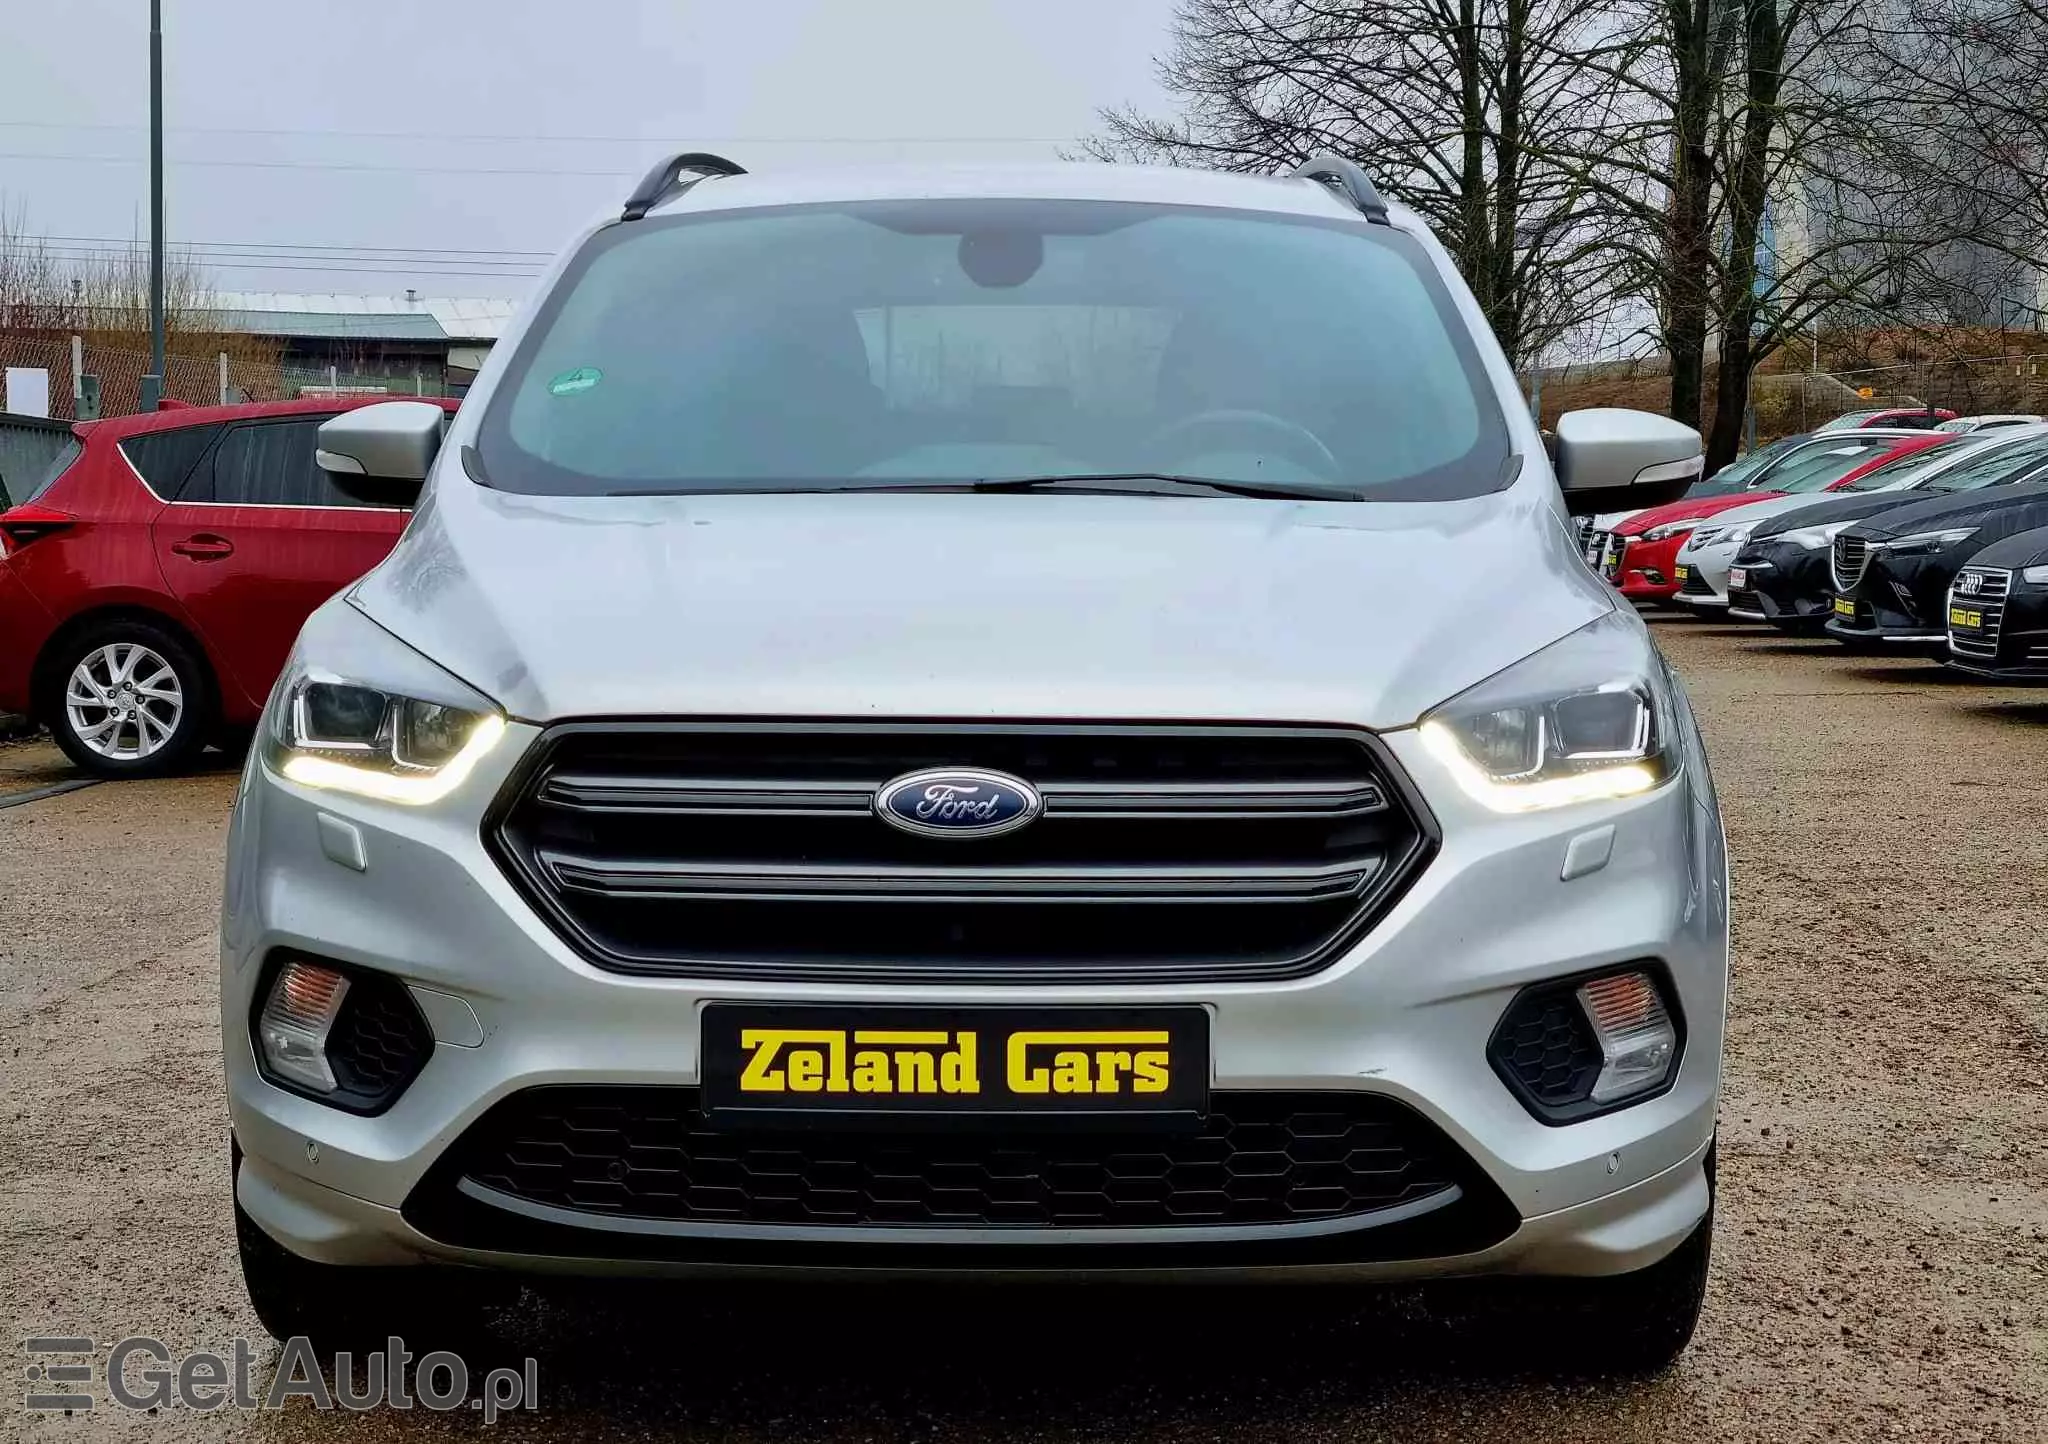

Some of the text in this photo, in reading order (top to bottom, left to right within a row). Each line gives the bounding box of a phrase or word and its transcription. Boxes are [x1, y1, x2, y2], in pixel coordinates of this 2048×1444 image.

[915, 784, 1000, 820] Ford
[740, 1029, 1170, 1094] Zeland Cars
